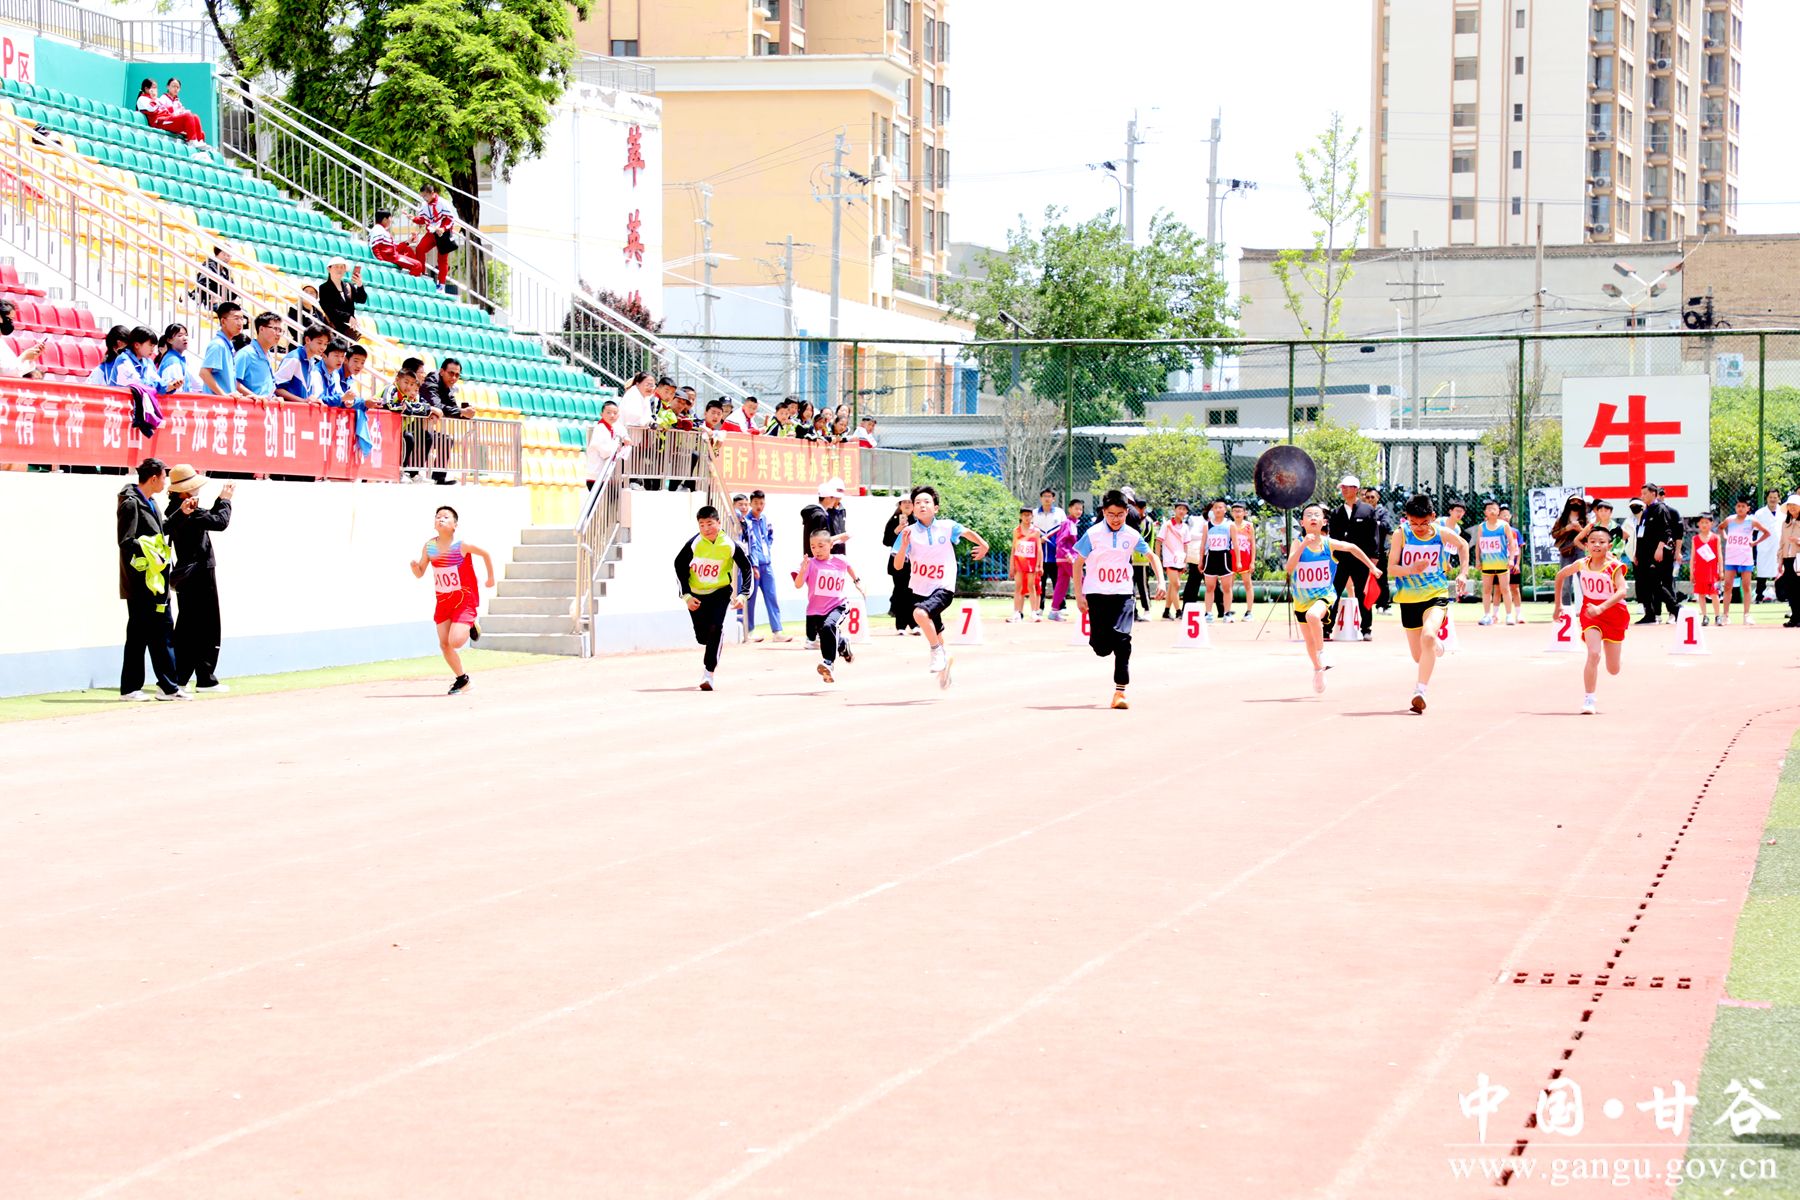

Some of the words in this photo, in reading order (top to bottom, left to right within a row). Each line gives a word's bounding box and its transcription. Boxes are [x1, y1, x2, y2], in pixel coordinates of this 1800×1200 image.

[1583, 395, 1689, 499] 生
[1481, 540, 1500, 549] 0145
[1728, 535, 1748, 545] 0582
[913, 562, 944, 579] 0025
[1099, 567, 1130, 583] 0024
[1299, 567, 1330, 582] 0005
[1581, 576, 1613, 594] 1001
[848, 607, 860, 634] 8
[961, 607, 973, 634] 7
[1187, 611, 1200, 638] 5
[1557, 613, 1572, 642] 2
[1684, 616, 1697, 645] 1
